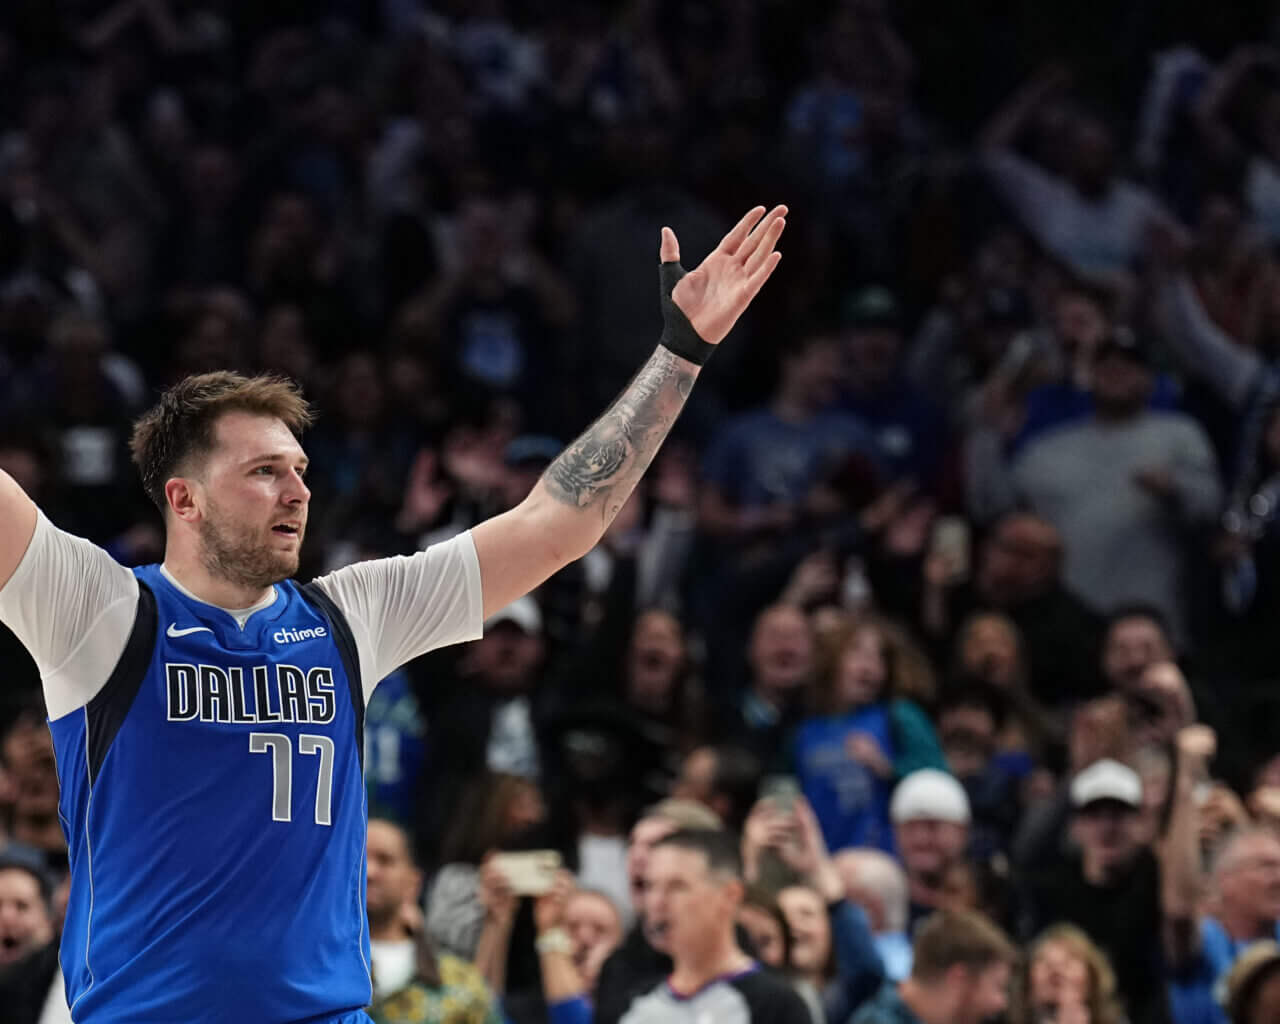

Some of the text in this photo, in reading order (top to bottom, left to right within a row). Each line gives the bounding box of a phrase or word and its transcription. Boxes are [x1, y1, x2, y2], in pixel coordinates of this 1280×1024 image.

[273, 625, 328, 645] chime
[165, 662, 336, 725] DALLAS
[249, 732, 335, 827] 77
